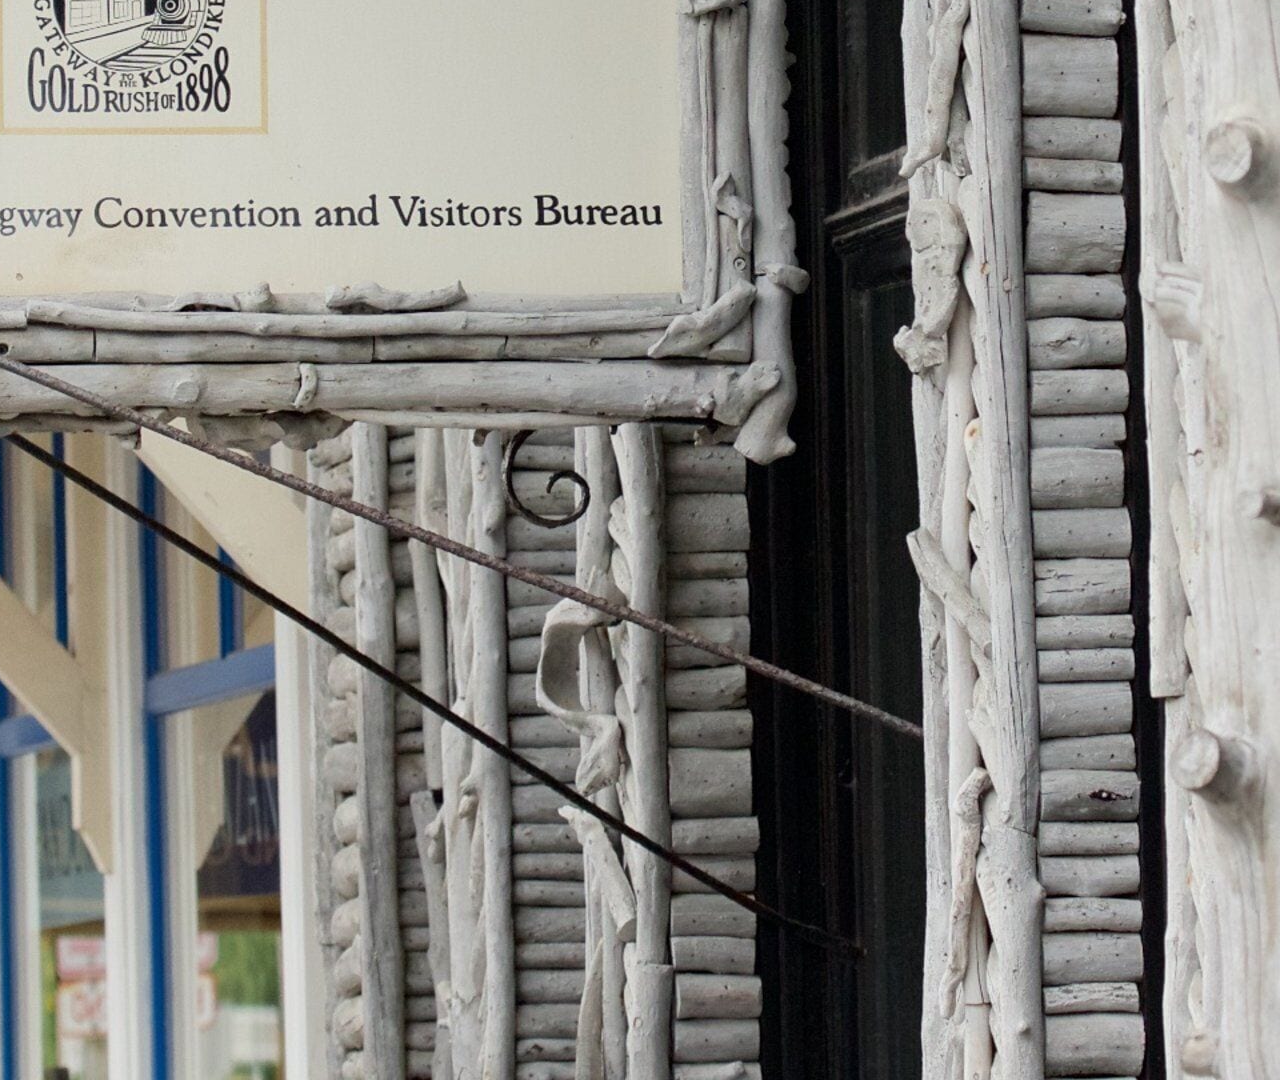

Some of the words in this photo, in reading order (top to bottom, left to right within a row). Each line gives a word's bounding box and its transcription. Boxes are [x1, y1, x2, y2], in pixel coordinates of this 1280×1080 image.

[27, 47, 100, 113] GOLD
[103, 89, 160, 113] RUSH
[161, 93, 176, 110] OF
[175, 46, 232, 113] 1898
[94, 197, 302, 229] Convention
[315, 193, 380, 228] and
[388, 195, 524, 228] Visitors
[533, 194, 663, 226] Bureau
